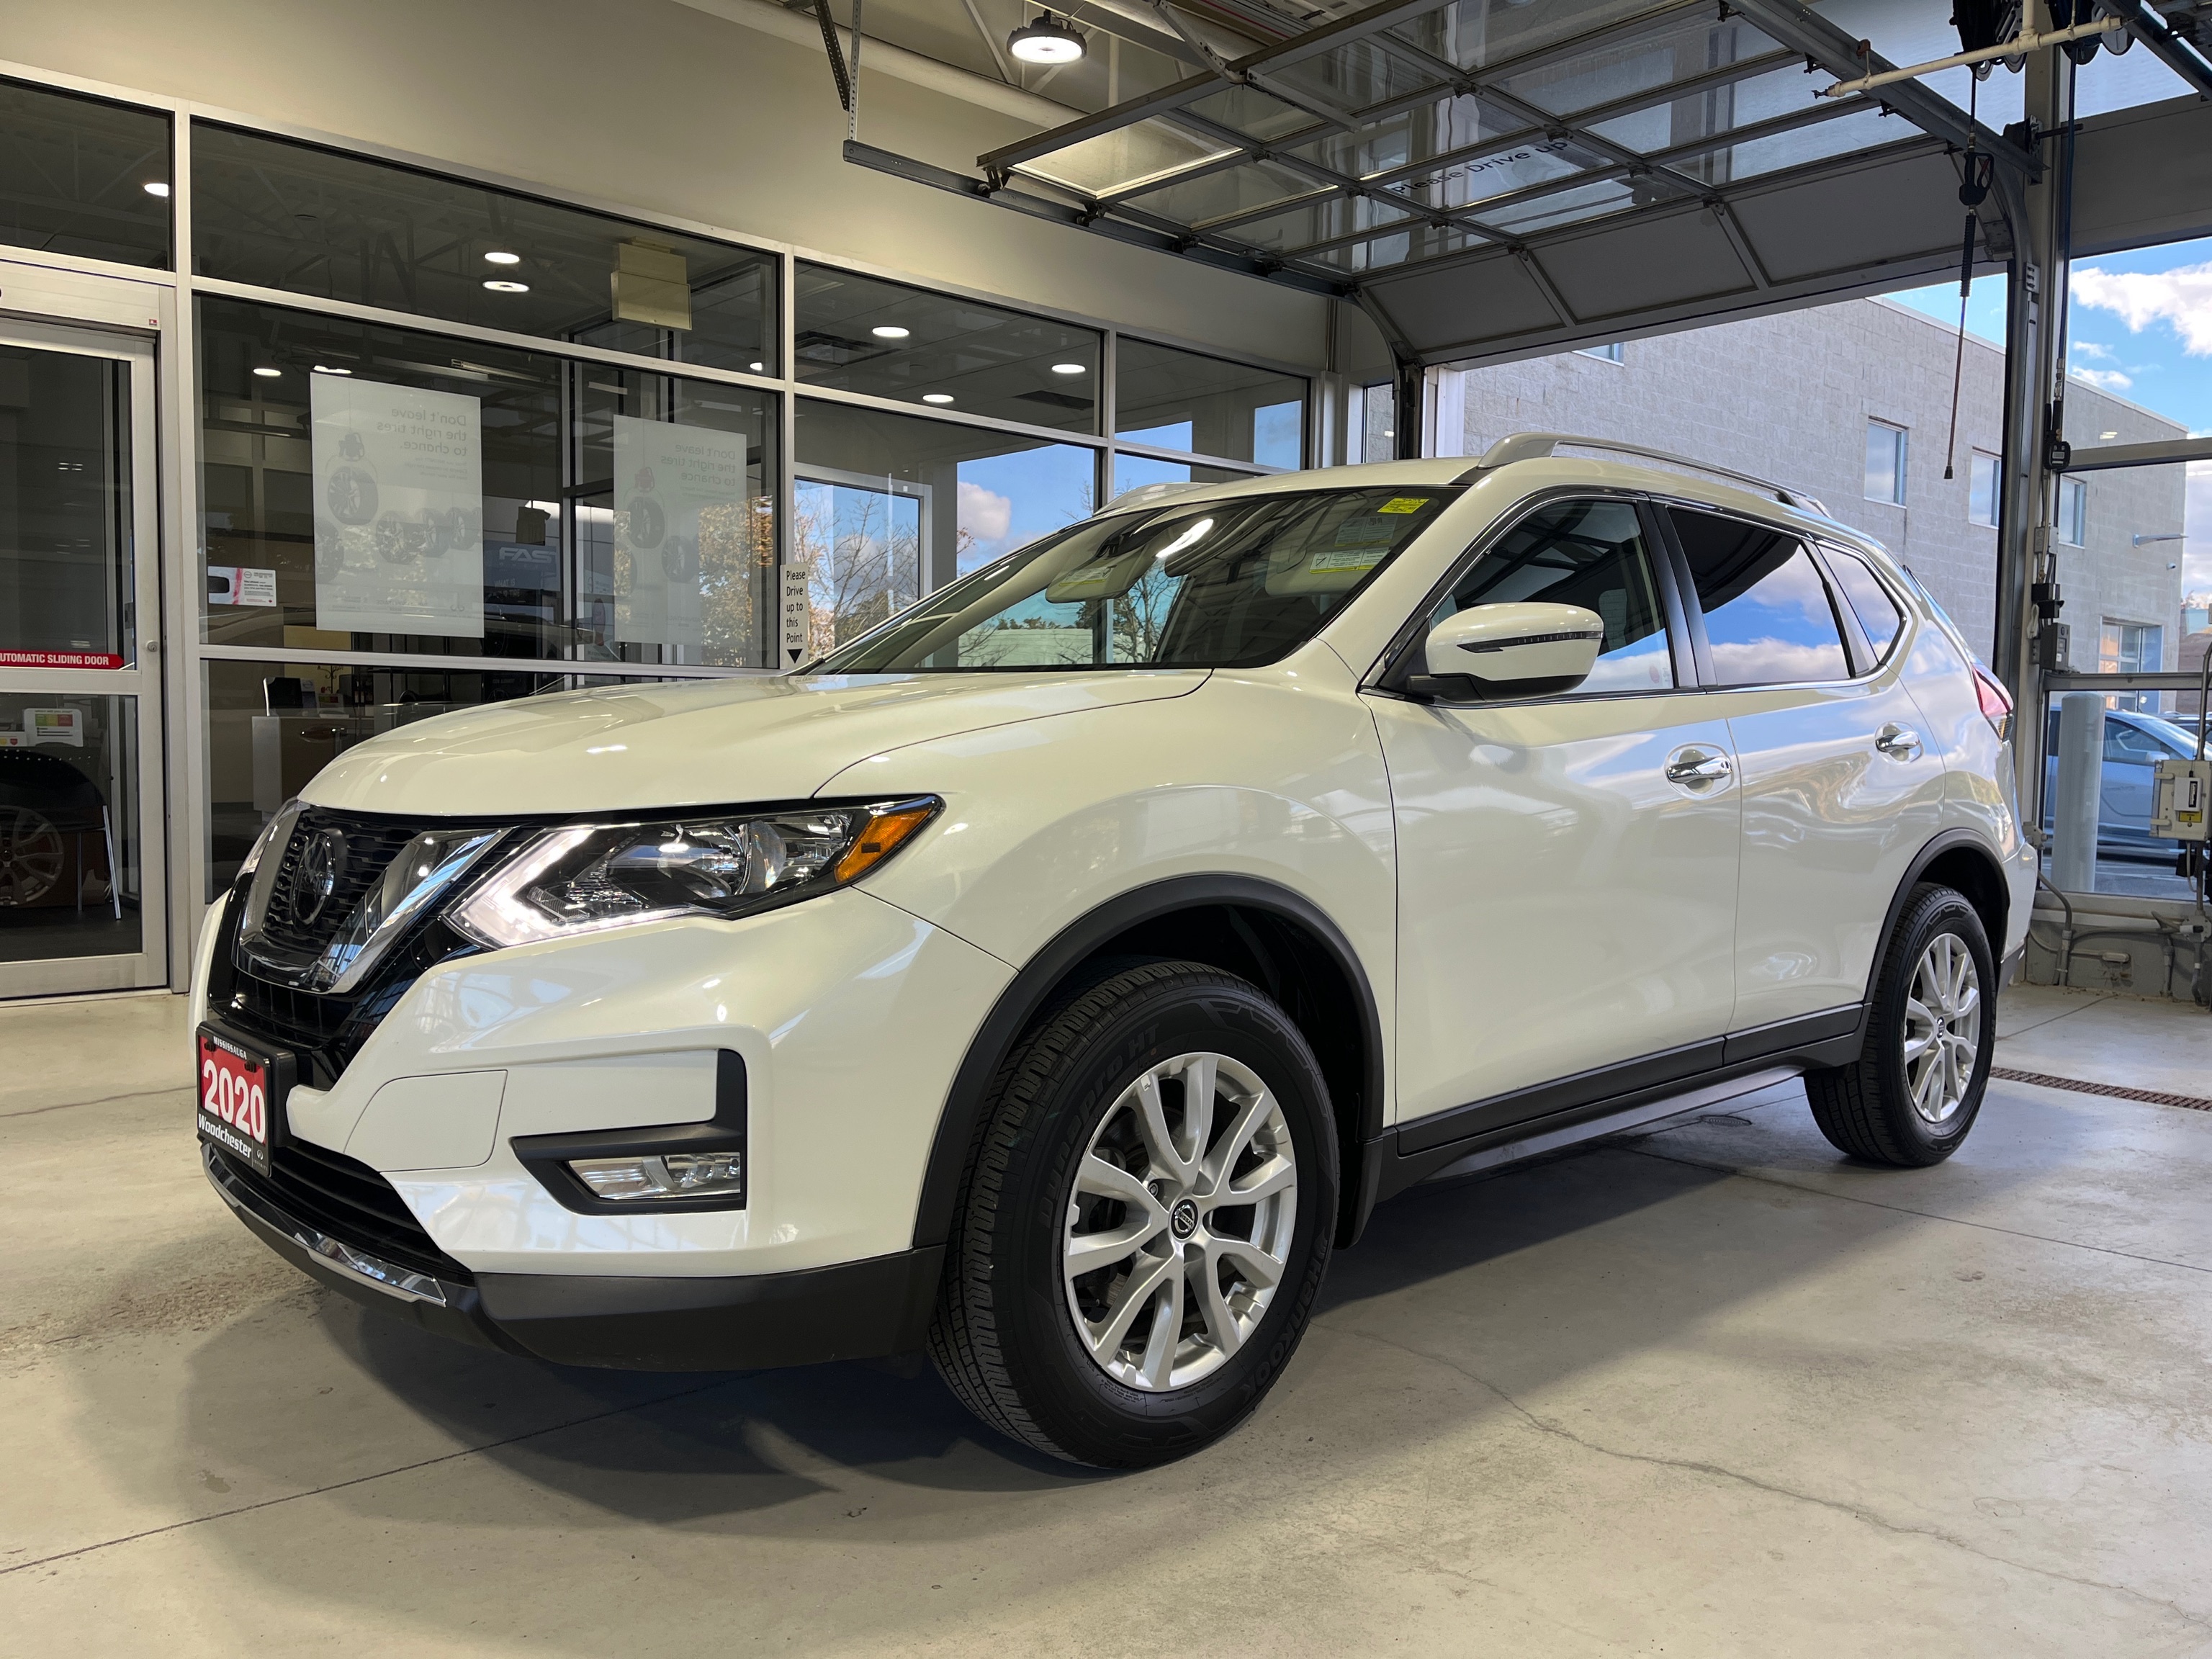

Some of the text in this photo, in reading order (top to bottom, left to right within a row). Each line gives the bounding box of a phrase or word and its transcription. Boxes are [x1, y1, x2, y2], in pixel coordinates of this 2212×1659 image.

[1391, 140, 1568, 194] Please Drive up
[786, 570, 806, 581] Please
[786, 586, 803, 596] Drive
[786, 603, 803, 613] up to
[786, 618, 798, 628] this
[786, 633, 803, 643] Point
[0, 653, 109, 665] UTOMATIC SLIDING DOOR
[213, 1036, 247, 1060] MISSISSAUGA
[1128, 1022, 1160, 1060] HT
[203, 1059, 266, 1144] 2020
[198, 1113, 252, 1159] Woodchester
[1179, 1212, 1193, 1228] NISSAN
